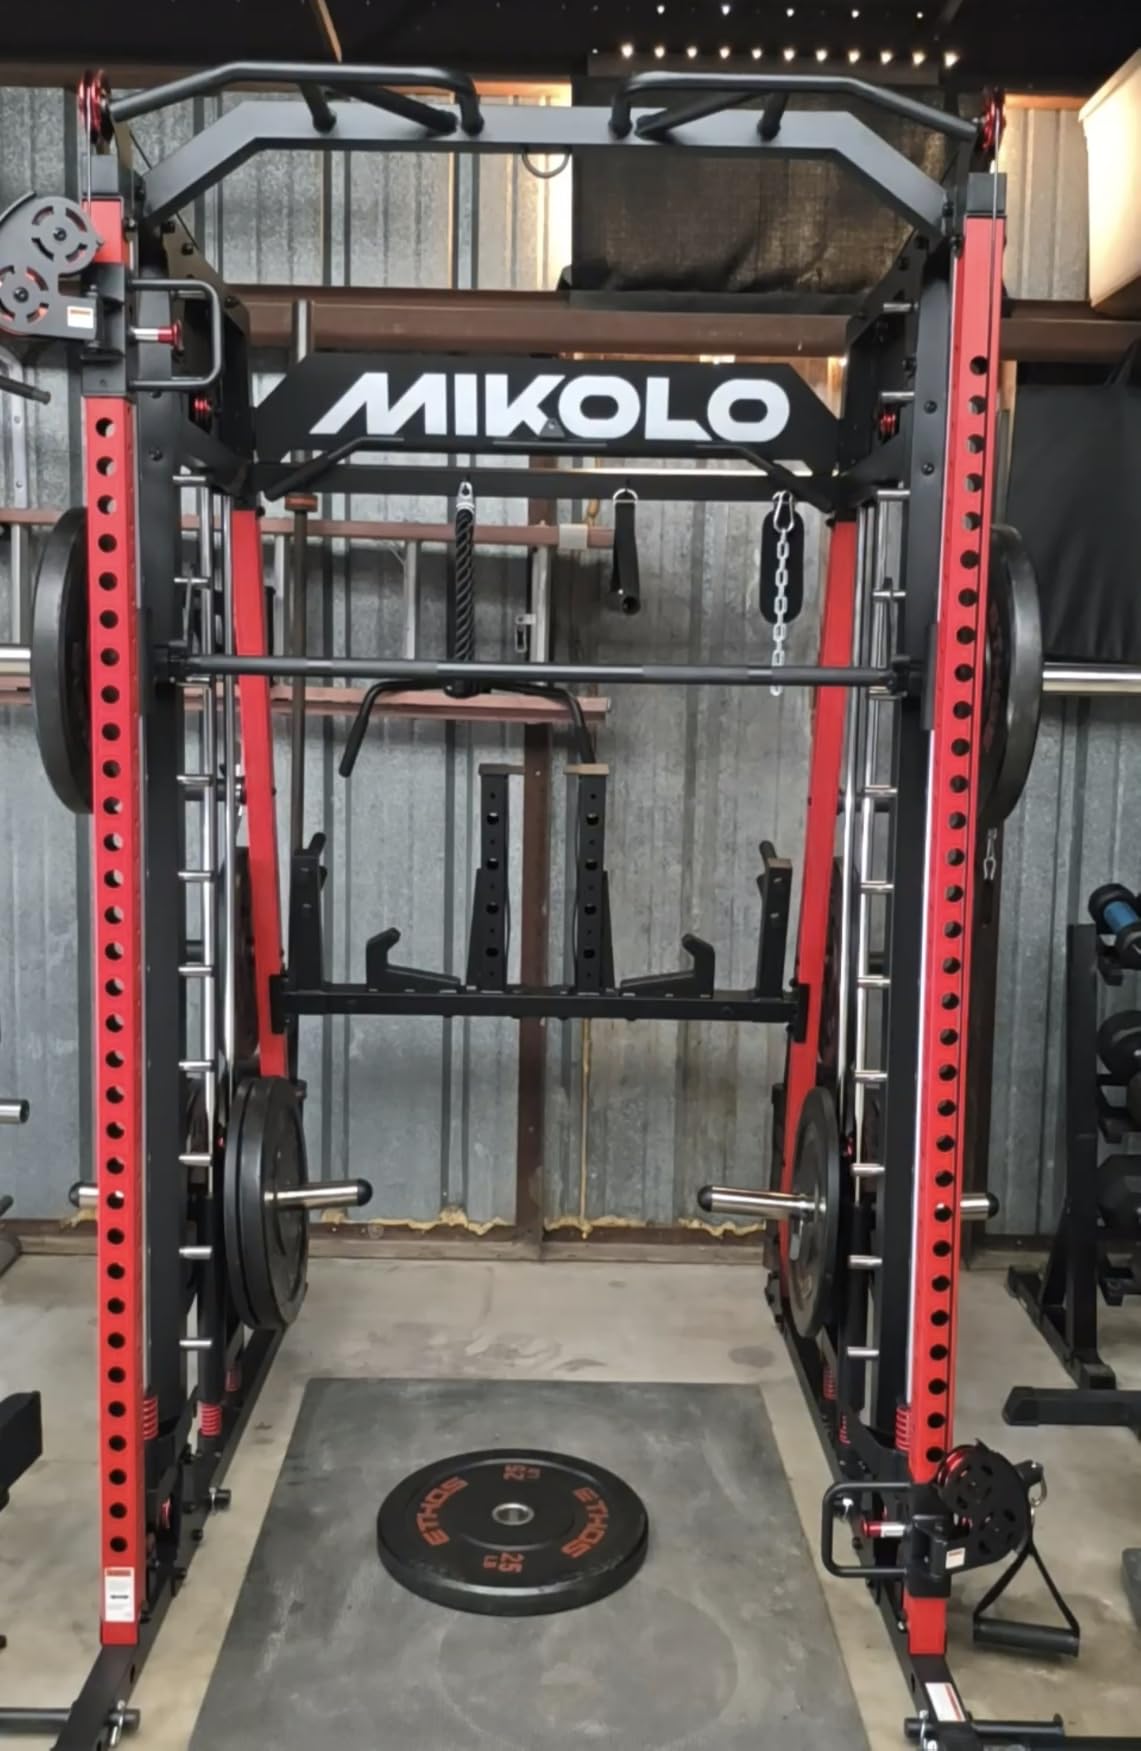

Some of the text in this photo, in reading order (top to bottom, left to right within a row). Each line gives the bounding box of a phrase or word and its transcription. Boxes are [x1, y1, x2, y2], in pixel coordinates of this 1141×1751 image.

[309, 372, 790, 442] MIKOLO
[416, 1476, 469, 1546] ETHOS
[561, 1487, 608, 1557] ETHOS
[499, 1552, 524, 1573] 25
